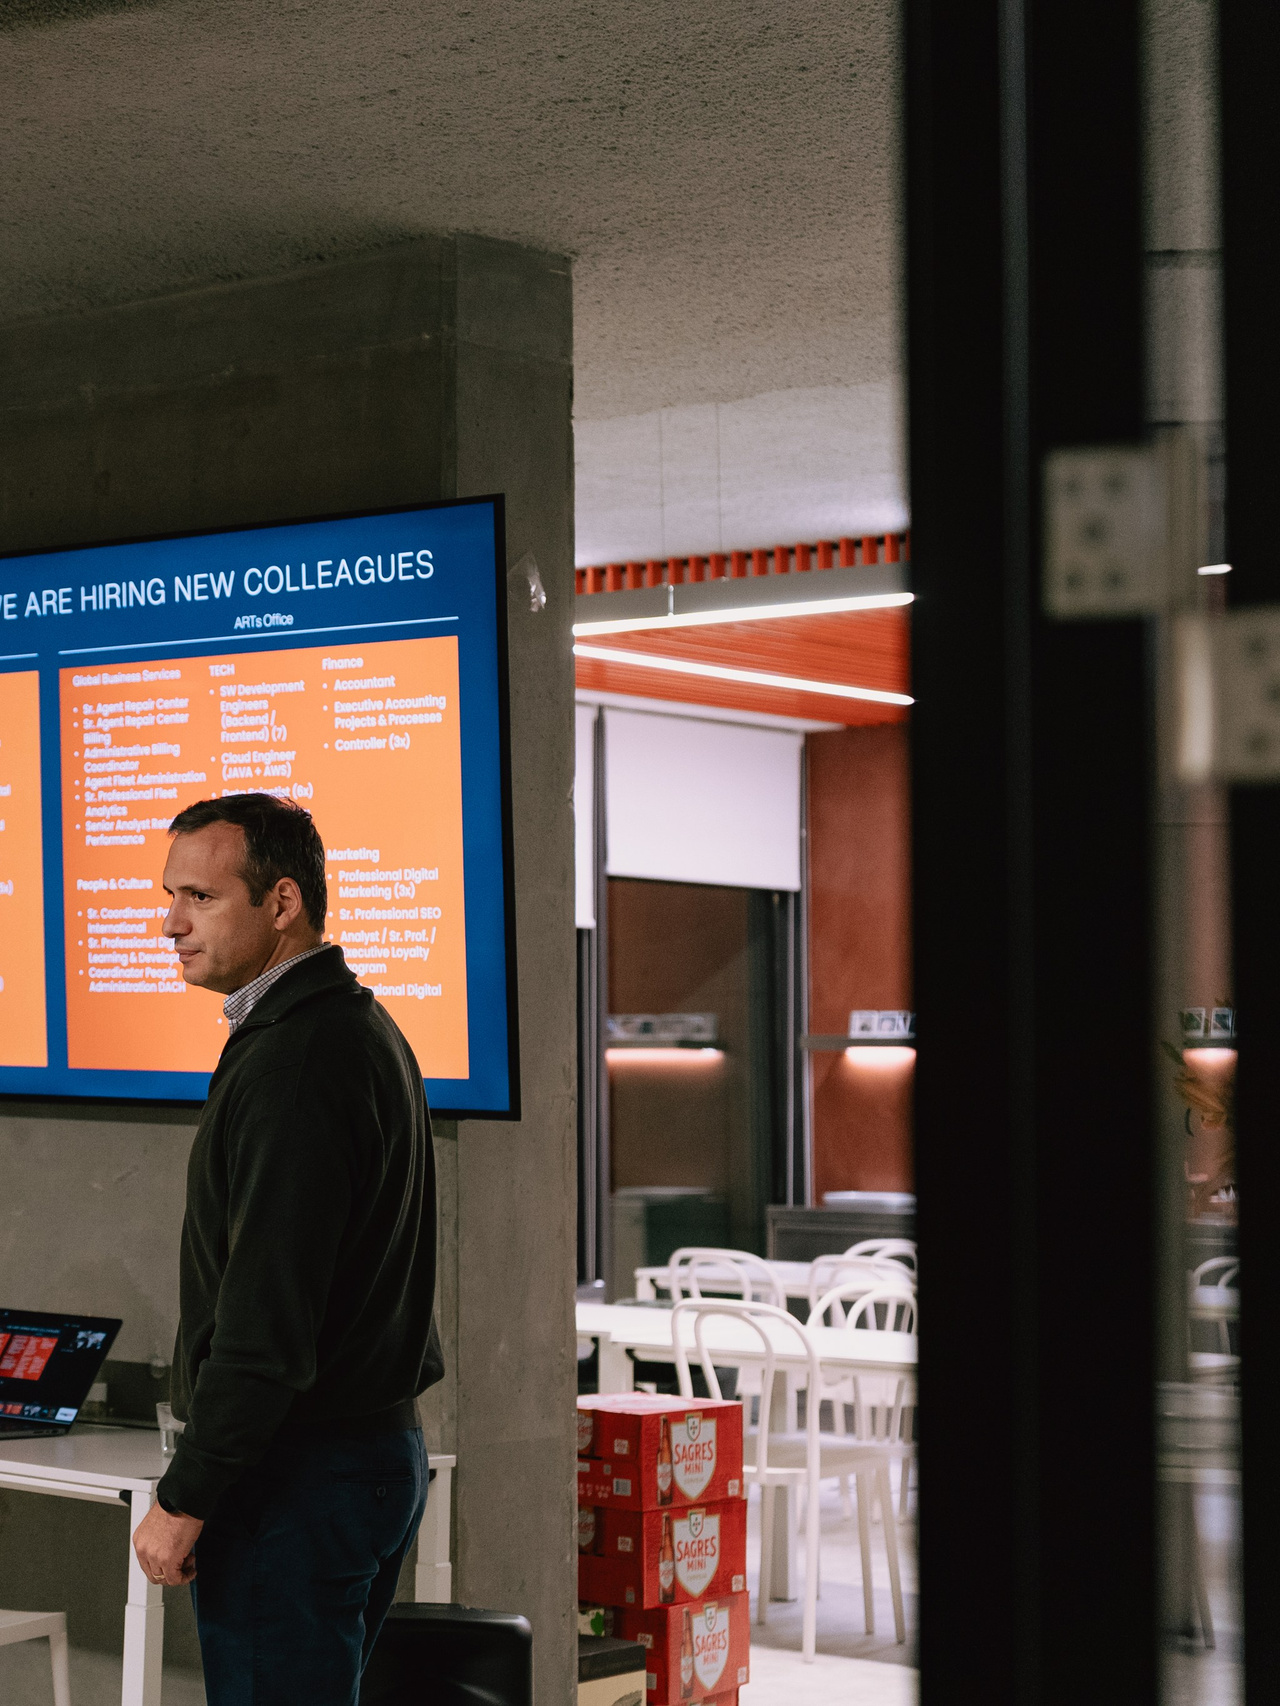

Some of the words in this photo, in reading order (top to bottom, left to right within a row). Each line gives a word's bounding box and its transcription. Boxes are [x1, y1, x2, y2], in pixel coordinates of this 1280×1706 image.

[24, 588, 72, 617] ARE
[80, 577, 166, 612] HIRING
[174, 570, 235, 603] NEW
[244, 550, 434, 596] COLLEAGUES
[234, 614, 262, 630] ARTs
[263, 613, 294, 627] Office
[209, 664, 235, 677] TECH
[322, 657, 363, 670] Finance
[72, 674, 101, 687] Global
[102, 672, 141, 685] Business
[142, 668, 181, 682] Services
[334, 676, 395, 691] Accountant
[220, 685, 237, 697] SW
[238, 680, 305, 696] Development
[83, 704, 95, 715] Sr.
[96, 701, 124, 716] Agent
[124, 698, 154, 714] Repair
[156, 697, 189, 710] Center
[221, 700, 268, 715] Engineers
[334, 699, 383, 713] Executive
[385, 694, 446, 710] Accounting
[83, 718, 95, 729] Sr.
[96, 716, 124, 731] Agent
[125, 713, 155, 729] Repair
[156, 712, 189, 725] Center
[221, 713, 268, 729] (Backend
[270, 710, 276, 727] /
[335, 714, 376, 731] Projects
[378, 714, 386, 726] &
[388, 712, 442, 725] Processes
[83, 732, 111, 747] Billing
[221, 726, 269, 743] Frontend)
[272, 725, 287, 742] (7)
[335, 737, 386, 751] Controller
[389, 732, 410, 750] (3x)
[84, 744, 150, 758] Administrative
[152, 742, 180, 757] Billing
[221, 752, 251, 765] Cloud
[252, 750, 296, 765] Engineer
[84, 760, 140, 773] Coordinator
[222, 764, 253, 781] (JAVA
[255, 767, 261, 777] +
[264, 761, 291, 778] AWS)
[84, 776, 112, 790] Agent
[113, 774, 136, 786] Fleet
[136, 770, 206, 784] Administration
[84, 791, 97, 802] Sr.
[98, 788, 153, 802] Professional
[154, 787, 178, 799] Fleet
[292, 782, 313, 800] (6x)
[85, 804, 128, 819] Analytics
[85, 819, 115, 832] Senior
[116, 818, 150, 833] Analyst
[86, 834, 145, 846] Performance
[327, 847, 380, 863] Marketing
[338, 869, 402, 882] Professional
[404, 867, 439, 884] Digital
[77, 878, 108, 893] People
[109, 878, 117, 890] &
[118, 878, 153, 890] Culture
[339, 884, 392, 900] Marketing
[394, 881, 415, 899] (3x)
[87, 908, 100, 919] Sr.
[100, 907, 156, 919] Coordinator
[340, 908, 353, 920] Sr.
[355, 907, 418, 919] Professional
[420, 907, 441, 919] SEO
[87, 922, 146, 934] International
[340, 930, 379, 945] Analyst
[381, 926, 387, 944] /
[389, 930, 403, 942] Sr.
[405, 929, 428, 941] Prof.
[430, 926, 436, 944] /
[88, 937, 100, 948] Sr.
[101, 936, 157, 948] Professional
[88, 951, 128, 967] Learning
[130, 952, 137, 963] &
[138, 952, 180, 966] Develop
[392, 946, 430, 961] Loyalty
[88, 966, 144, 978] Coordinator
[145, 966, 177, 980] People
[349, 963, 387, 977] rogram
[89, 980, 157, 992] Administration
[158, 981, 186, 992] DACH
[407, 984, 442, 999] Digital
[674, 1440, 713, 1464] SAGRES
[684, 1462, 703, 1475] MINI
[677, 1537, 717, 1561] SAGRES
[687, 1559, 706, 1572] MINI
[695, 1630, 726, 1656] SAGRES
